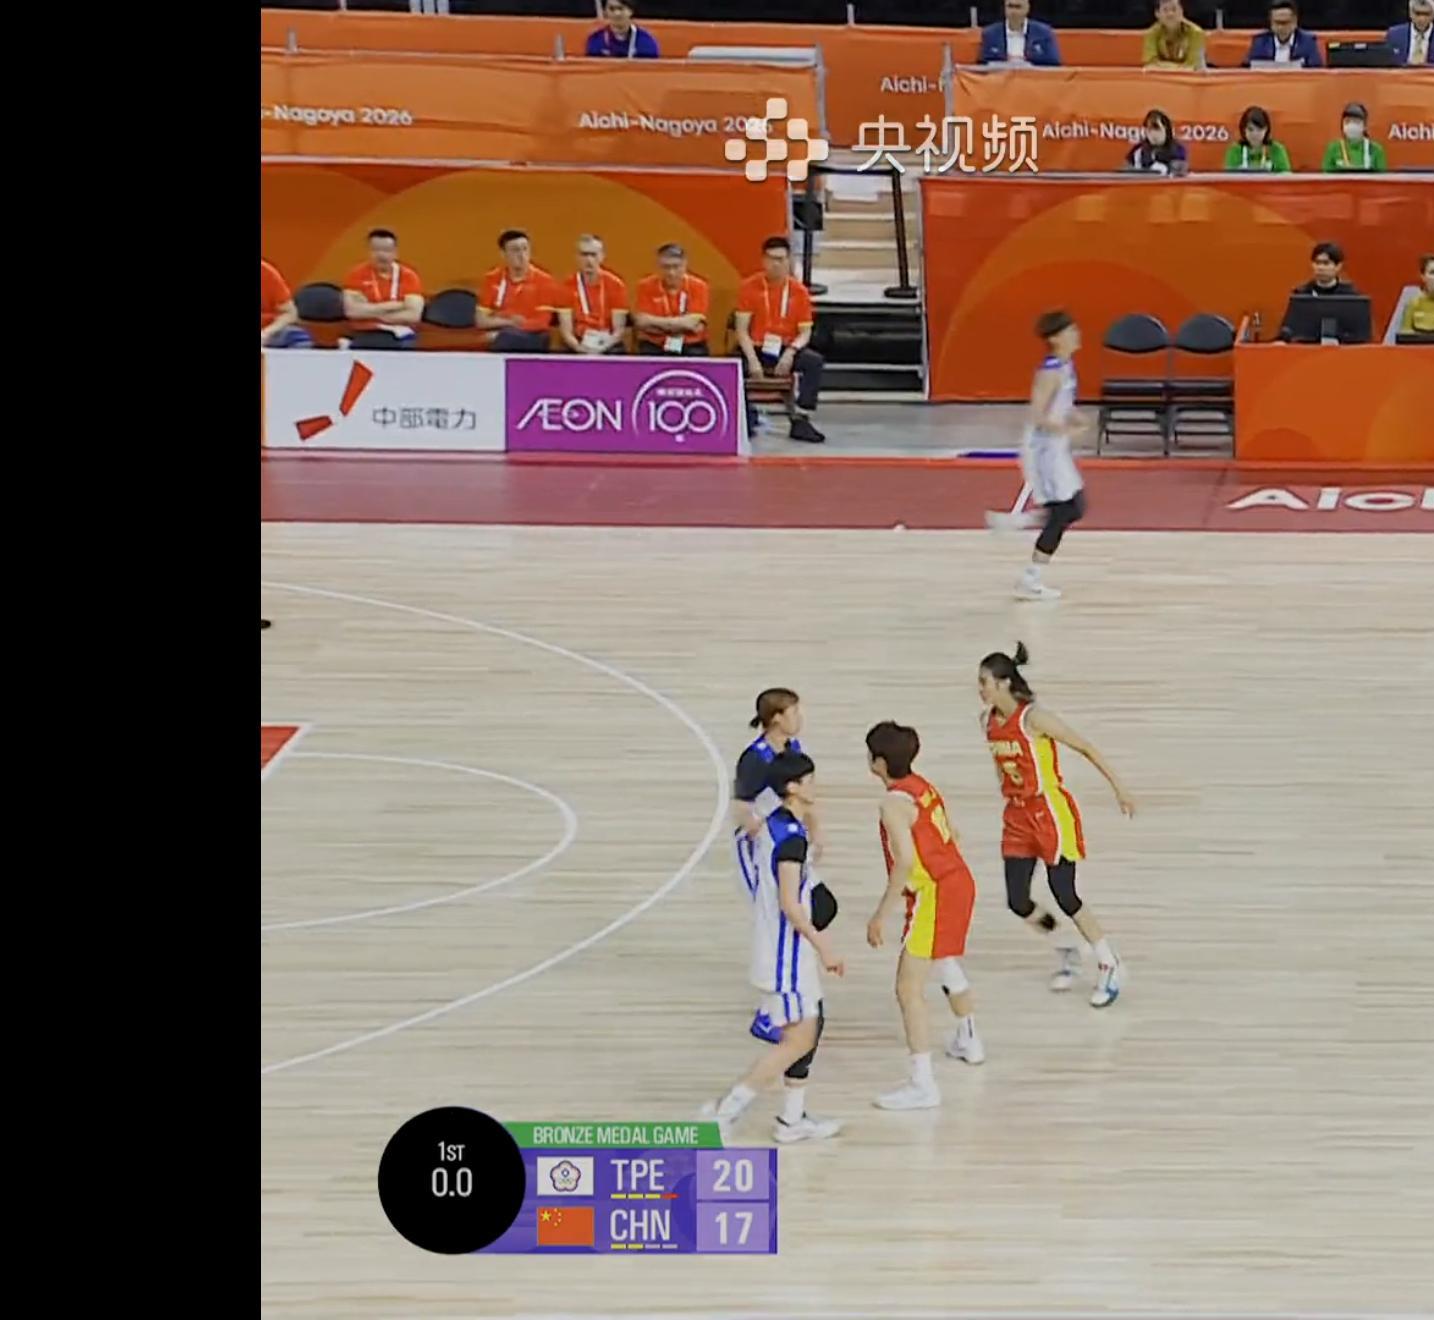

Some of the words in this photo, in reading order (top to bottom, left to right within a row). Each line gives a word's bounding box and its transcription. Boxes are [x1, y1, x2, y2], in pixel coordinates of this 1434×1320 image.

[359, 107, 413, 125] 2026
[579, 111, 717, 138] Aichi-Nagoya
[1183, 125, 1229, 141] 2026
[372, 407, 477, 430] 中部電力
[648, 400, 717, 433] 100
